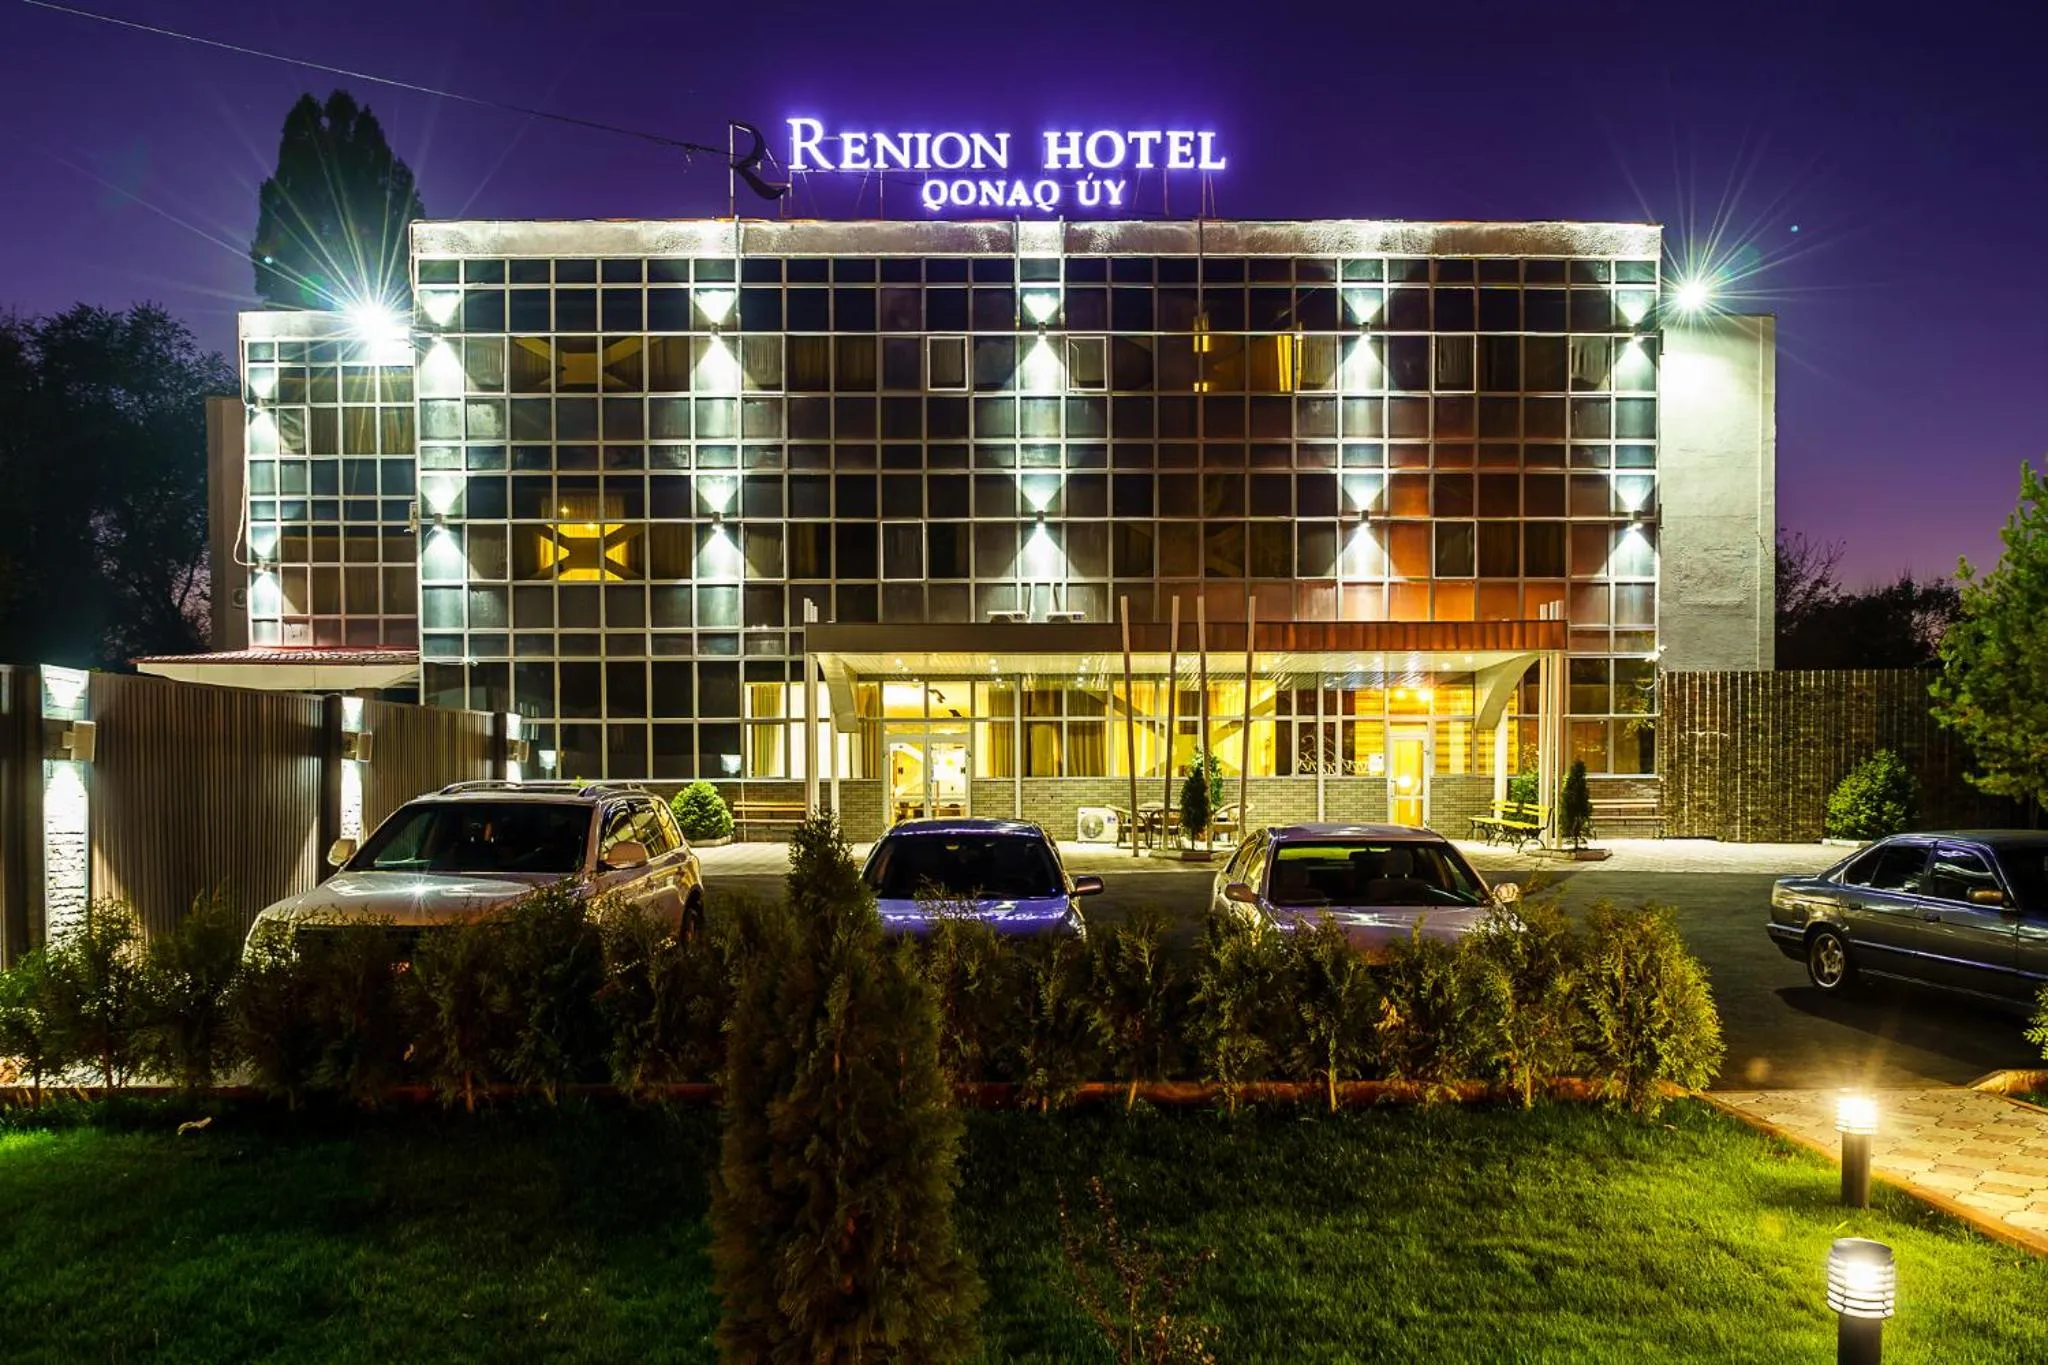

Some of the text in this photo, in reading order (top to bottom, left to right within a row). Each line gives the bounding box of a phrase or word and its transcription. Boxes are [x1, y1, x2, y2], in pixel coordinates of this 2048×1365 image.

[786, 117, 1227, 172] RENION HOTEL
[921, 173, 1127, 212] QONAQ ÚY
